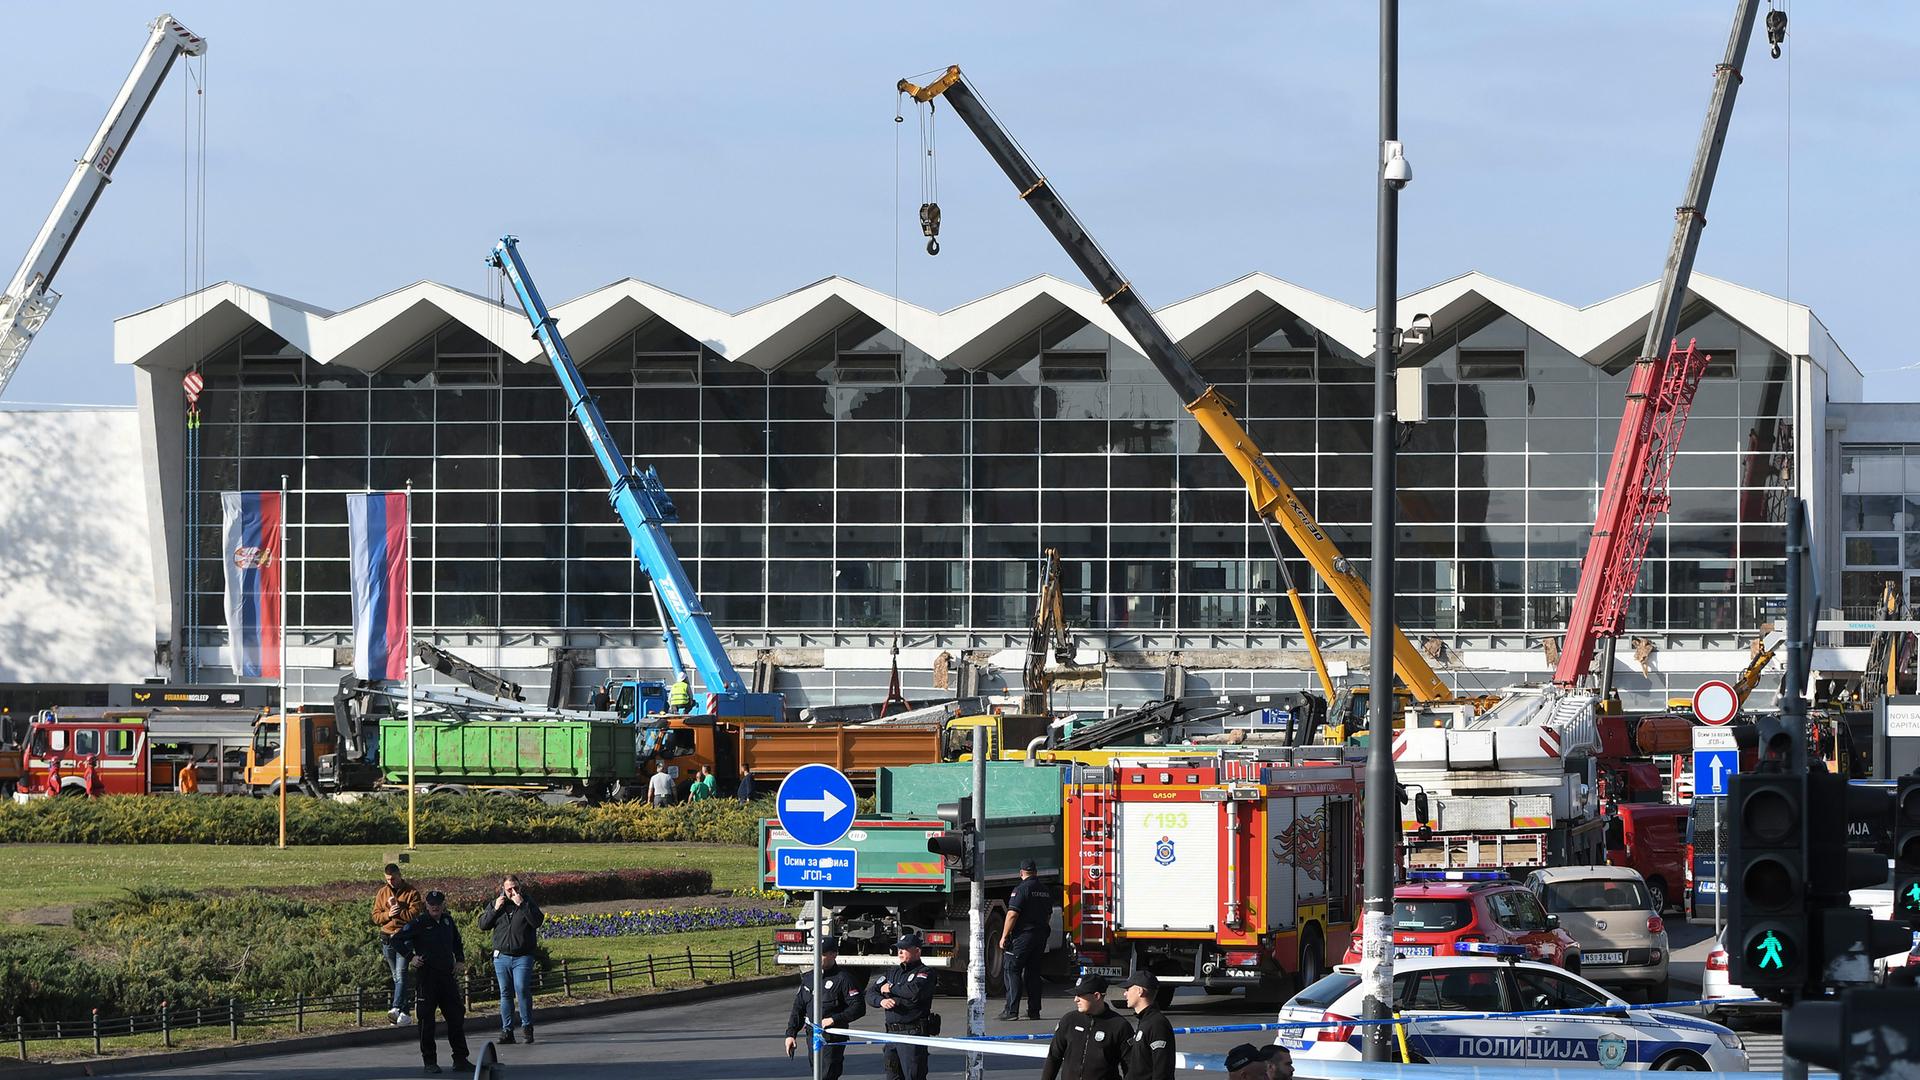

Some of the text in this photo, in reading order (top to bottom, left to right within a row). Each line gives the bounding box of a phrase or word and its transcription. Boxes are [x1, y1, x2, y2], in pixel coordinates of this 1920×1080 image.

[1889, 712, 1909, 720] NOVI
[1157, 813, 1188, 828] 193
[784, 855, 806, 867] Осим
[807, 857, 818, 867] за
[801, 870, 832, 882] ЈГСП-а
[1458, 1036, 1589, 1060] ПОЛИЦИЈА
